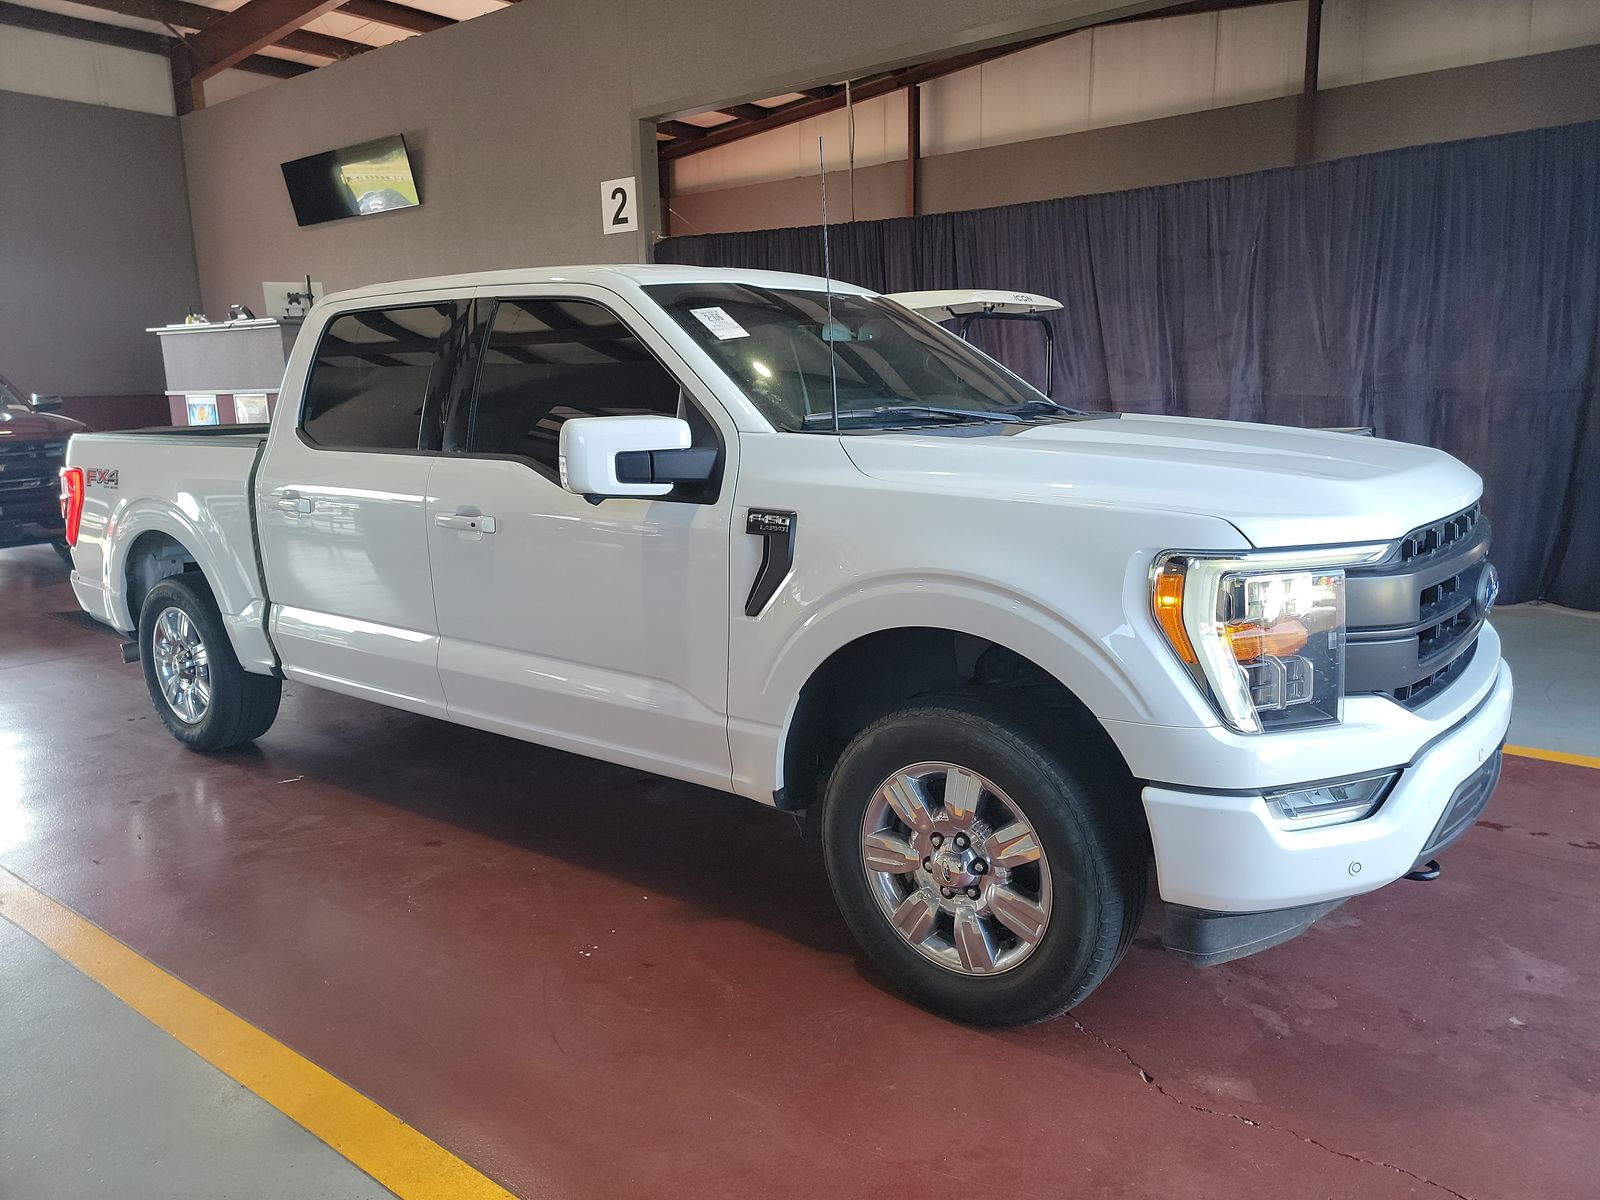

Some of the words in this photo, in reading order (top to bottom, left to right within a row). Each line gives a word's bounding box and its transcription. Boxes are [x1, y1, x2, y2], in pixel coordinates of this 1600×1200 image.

[611, 187, 628, 225] 2
[1012, 294, 1033, 302] ICON
[86, 468, 119, 487] FX4
[748, 513, 789, 526] F-150
